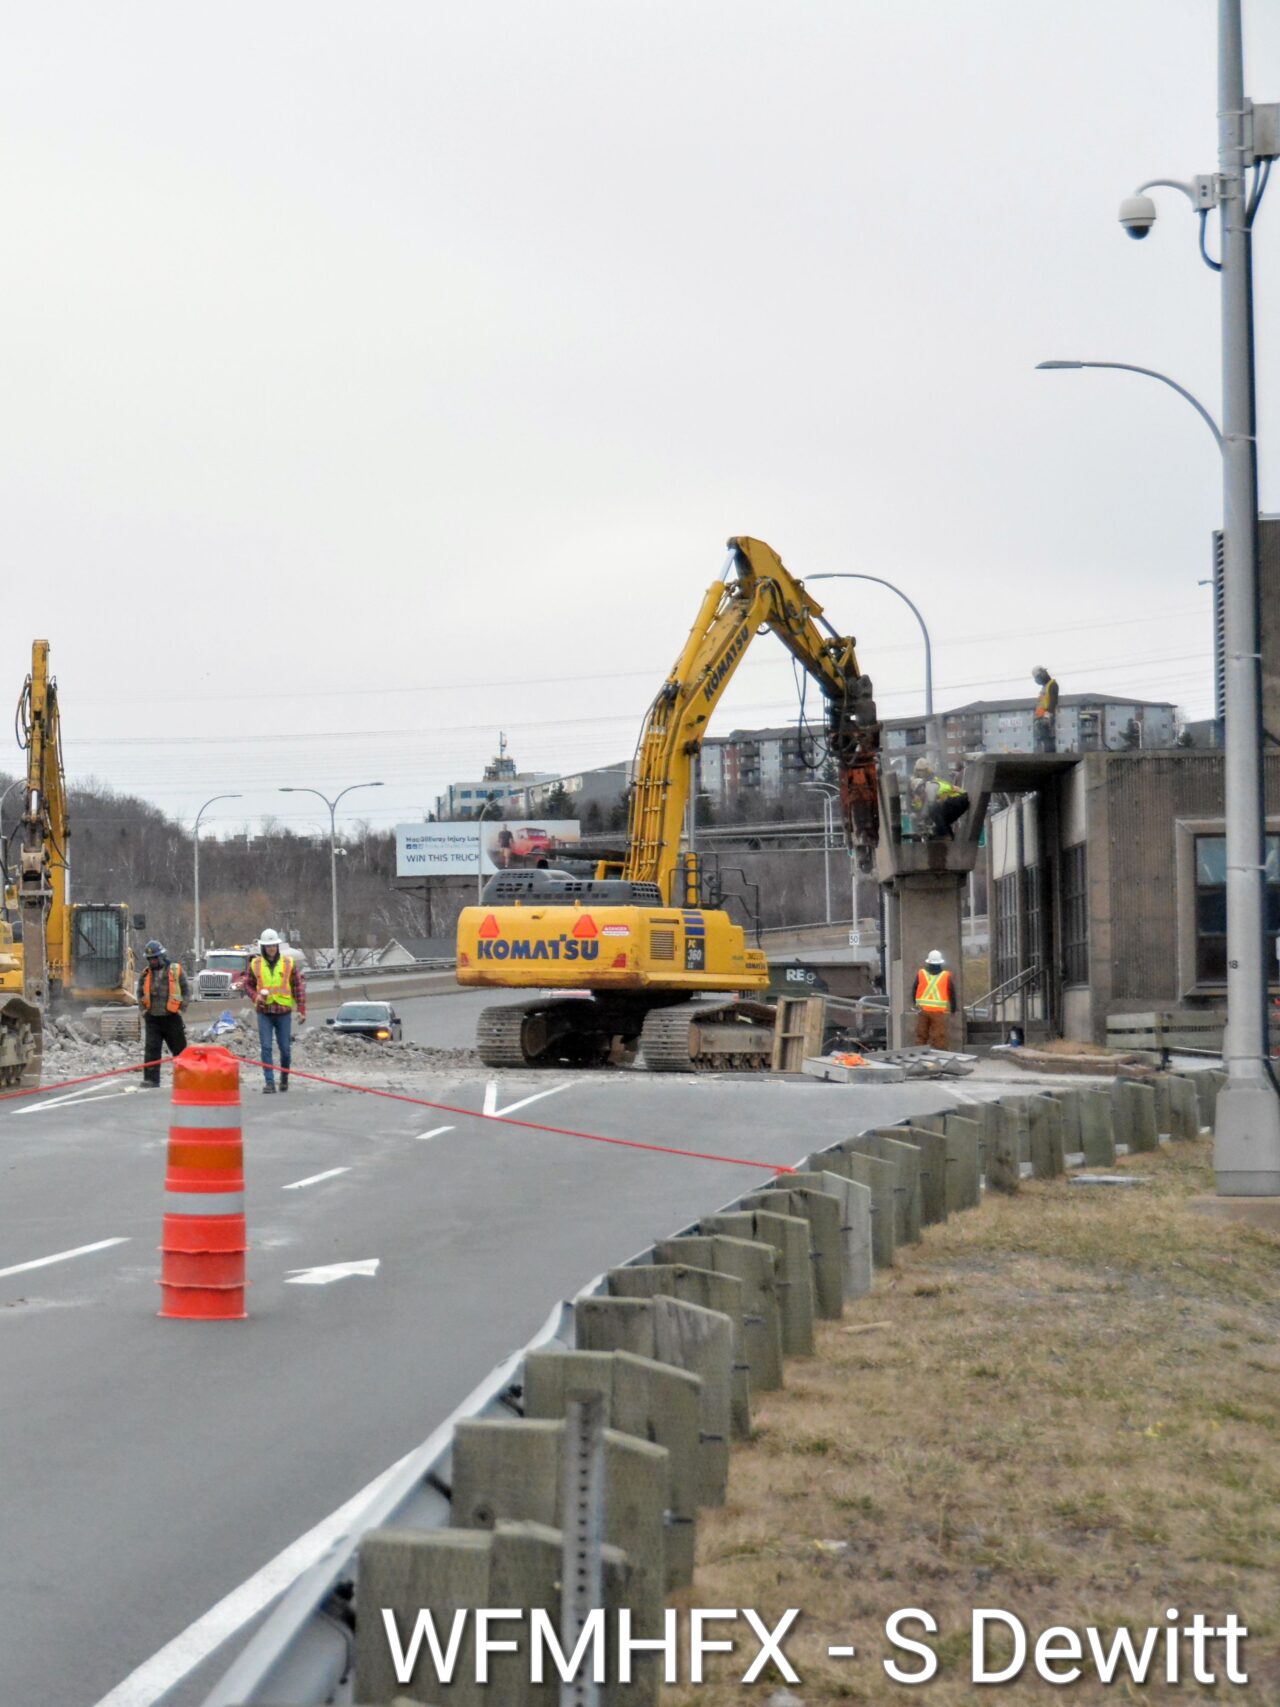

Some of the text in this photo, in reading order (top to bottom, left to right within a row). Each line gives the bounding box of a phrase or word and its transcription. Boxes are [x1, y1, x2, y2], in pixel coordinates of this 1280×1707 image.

[704, 625, 750, 702] KOMATSU
[406, 853, 480, 863] WIN THIS TRUCK
[477, 934, 598, 960] KOMATSU
[688, 949, 702, 961] 360
